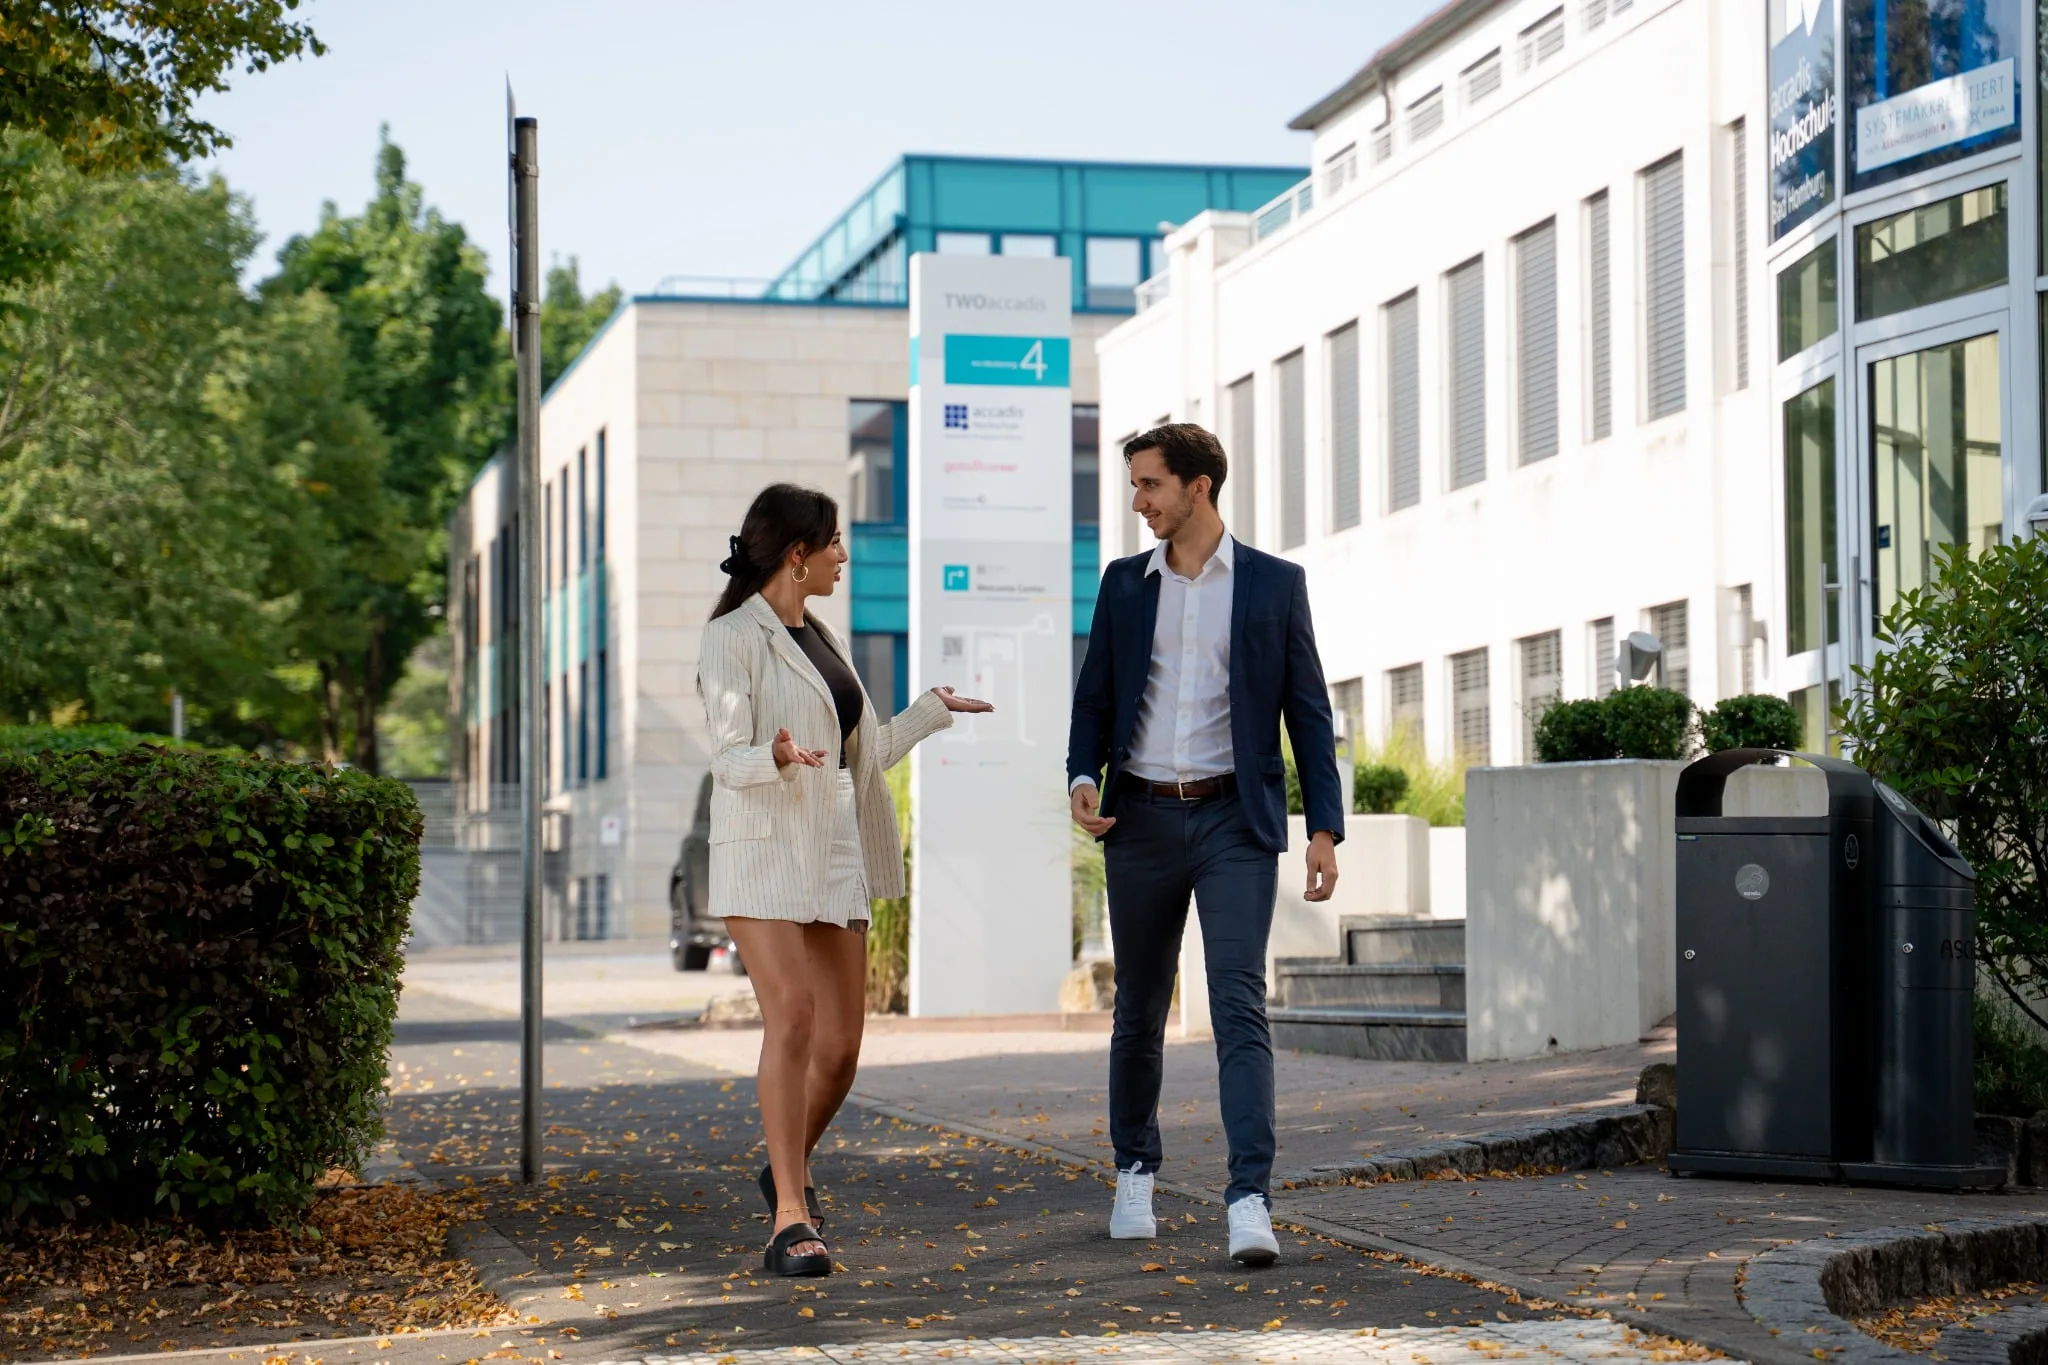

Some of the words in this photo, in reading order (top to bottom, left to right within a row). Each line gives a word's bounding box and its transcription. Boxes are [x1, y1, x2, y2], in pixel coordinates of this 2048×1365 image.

[1771, 87, 1836, 170] Hochschule
[1865, 75, 2005, 139] SYSTEMAKKRETIERT
[1771, 185, 1787, 225] Bad
[1787, 169, 1825, 214] Homburg
[944, 293, 1047, 312] TWOaccadis
[1019, 340, 1048, 381] 4
